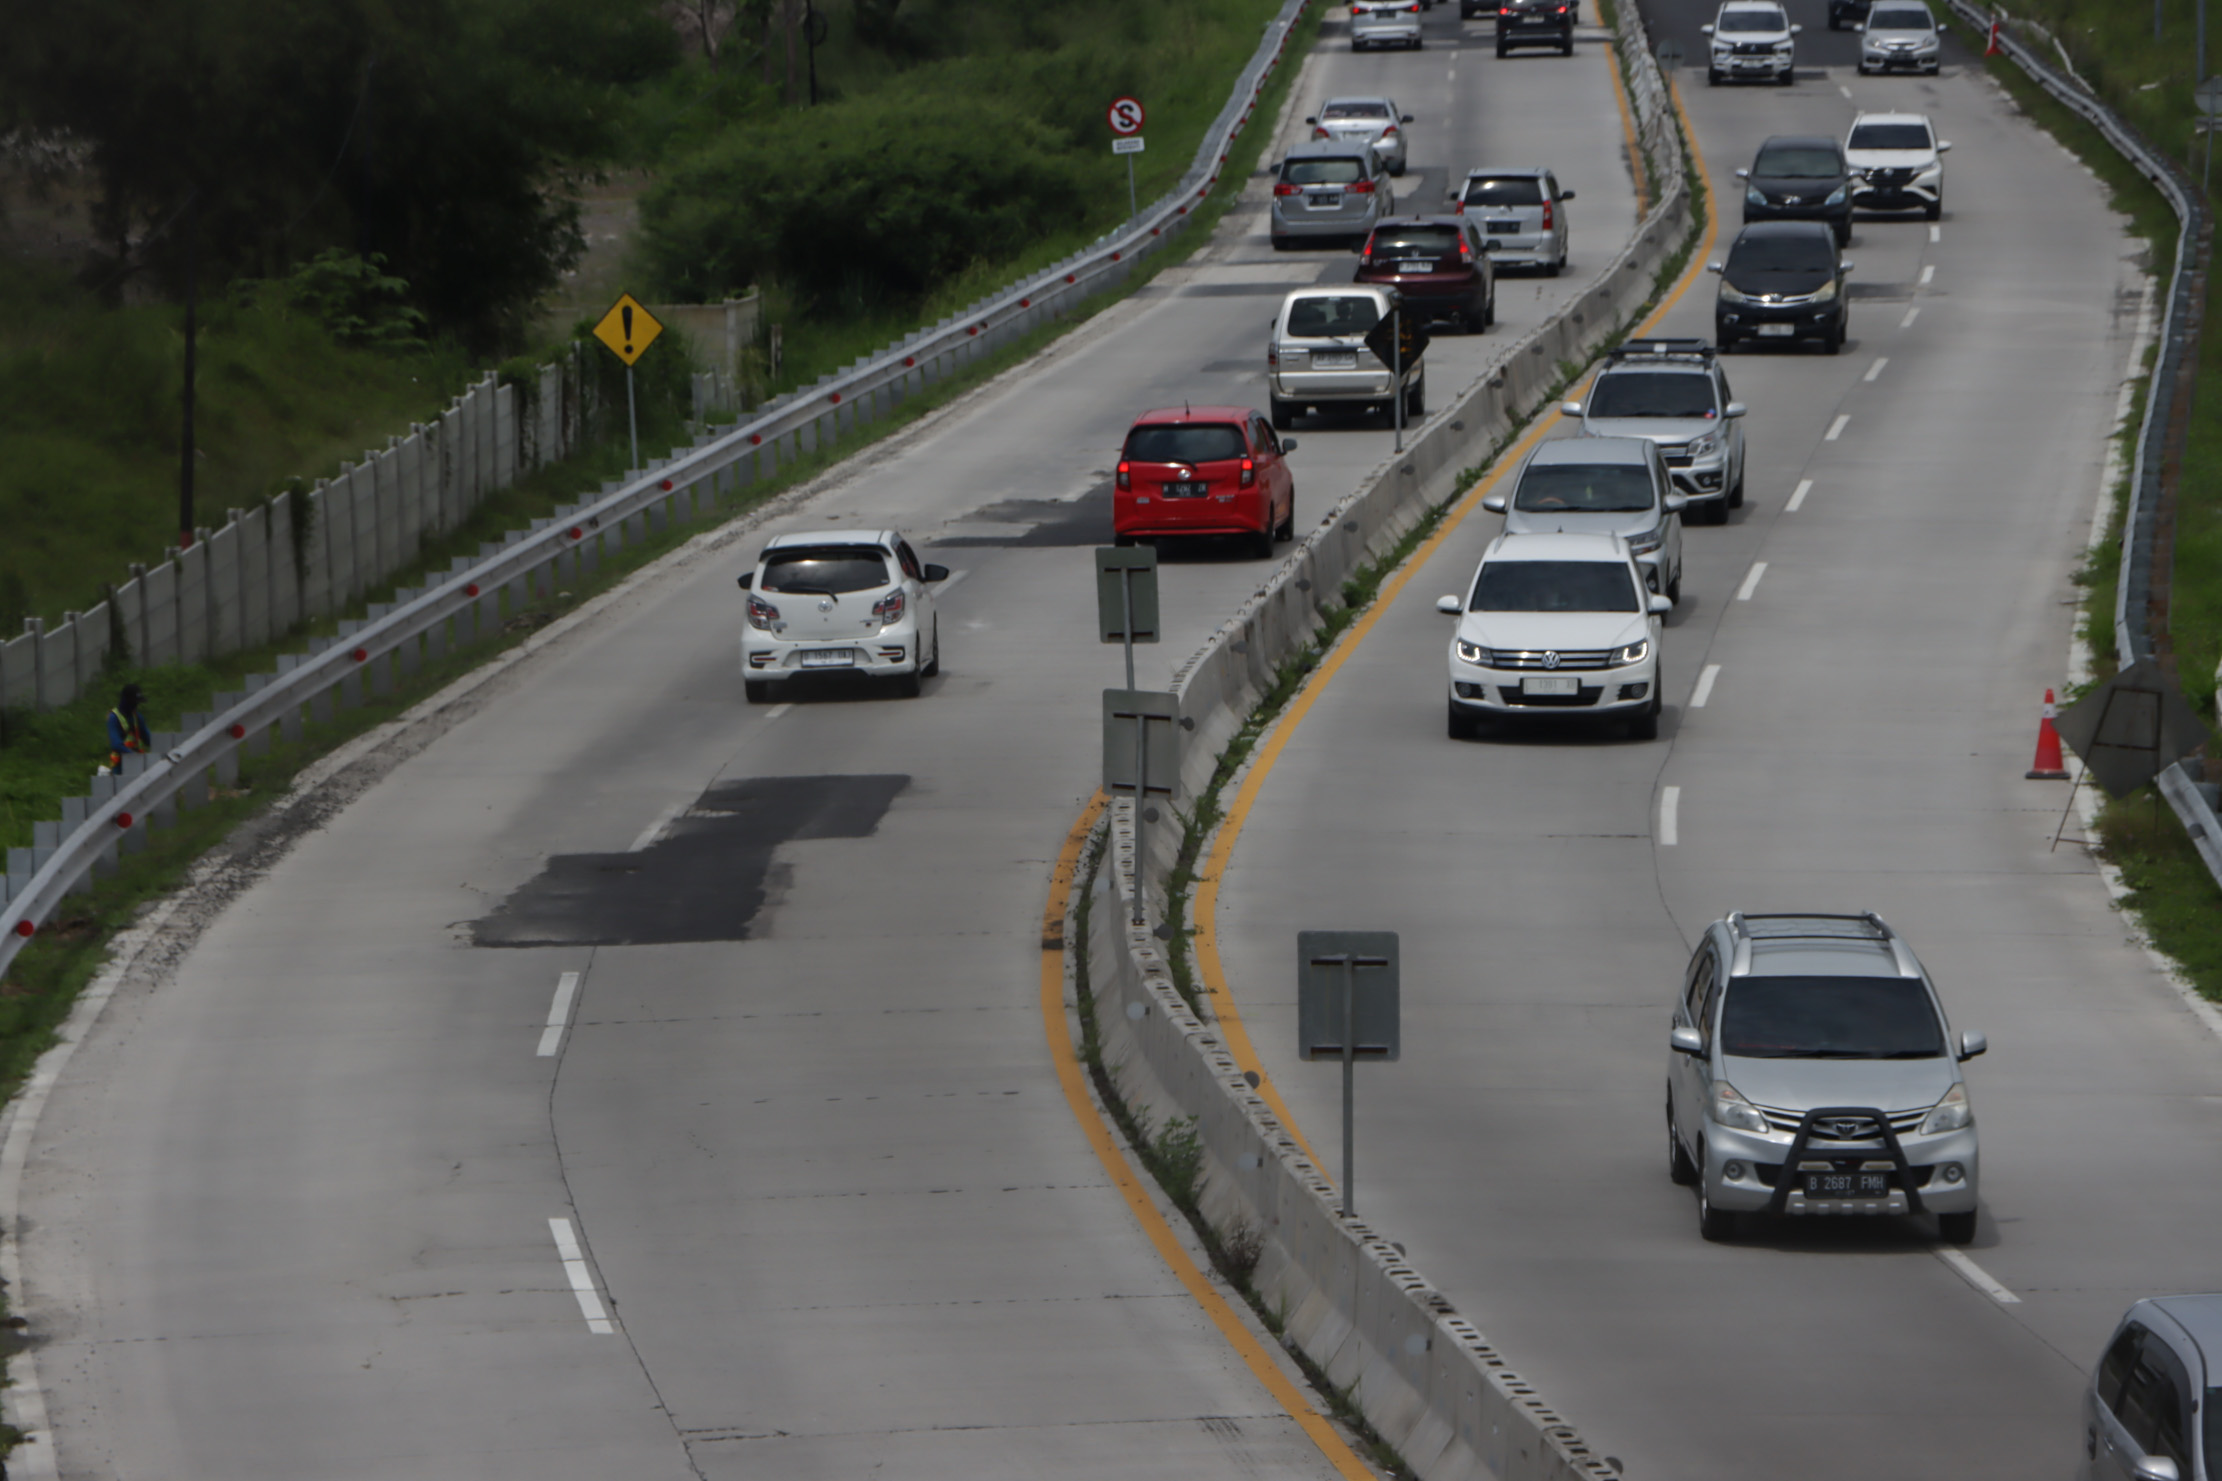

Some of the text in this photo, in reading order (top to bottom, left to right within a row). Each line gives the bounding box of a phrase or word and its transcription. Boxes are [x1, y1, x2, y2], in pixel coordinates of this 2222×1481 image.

[1810, 1176, 1884, 1190] B 2687 FMH
